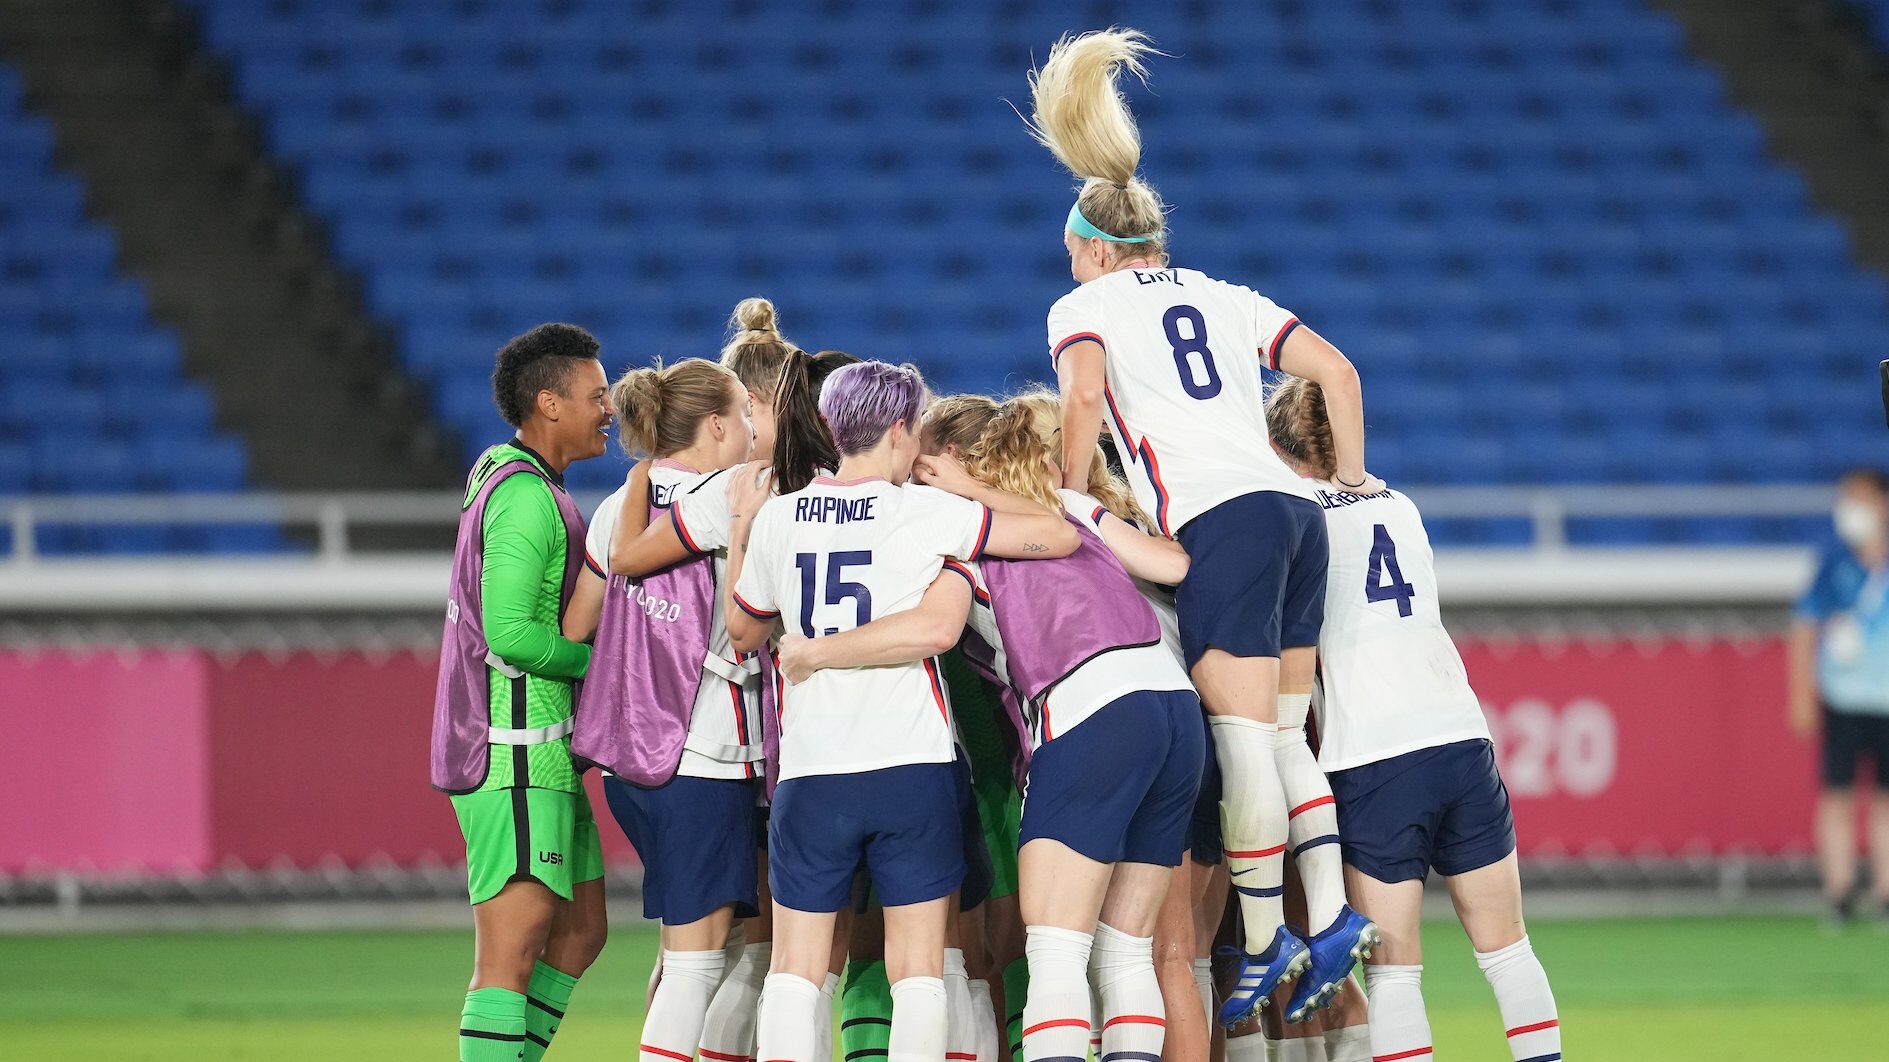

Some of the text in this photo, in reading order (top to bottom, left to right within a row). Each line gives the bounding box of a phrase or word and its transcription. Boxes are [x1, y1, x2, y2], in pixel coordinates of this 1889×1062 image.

[1163, 304, 1222, 400] 8
[795, 496, 878, 524] RAPINOE
[796, 550, 872, 638] 15
[1365, 524, 1415, 618] 4
[539, 851, 563, 866] USA
